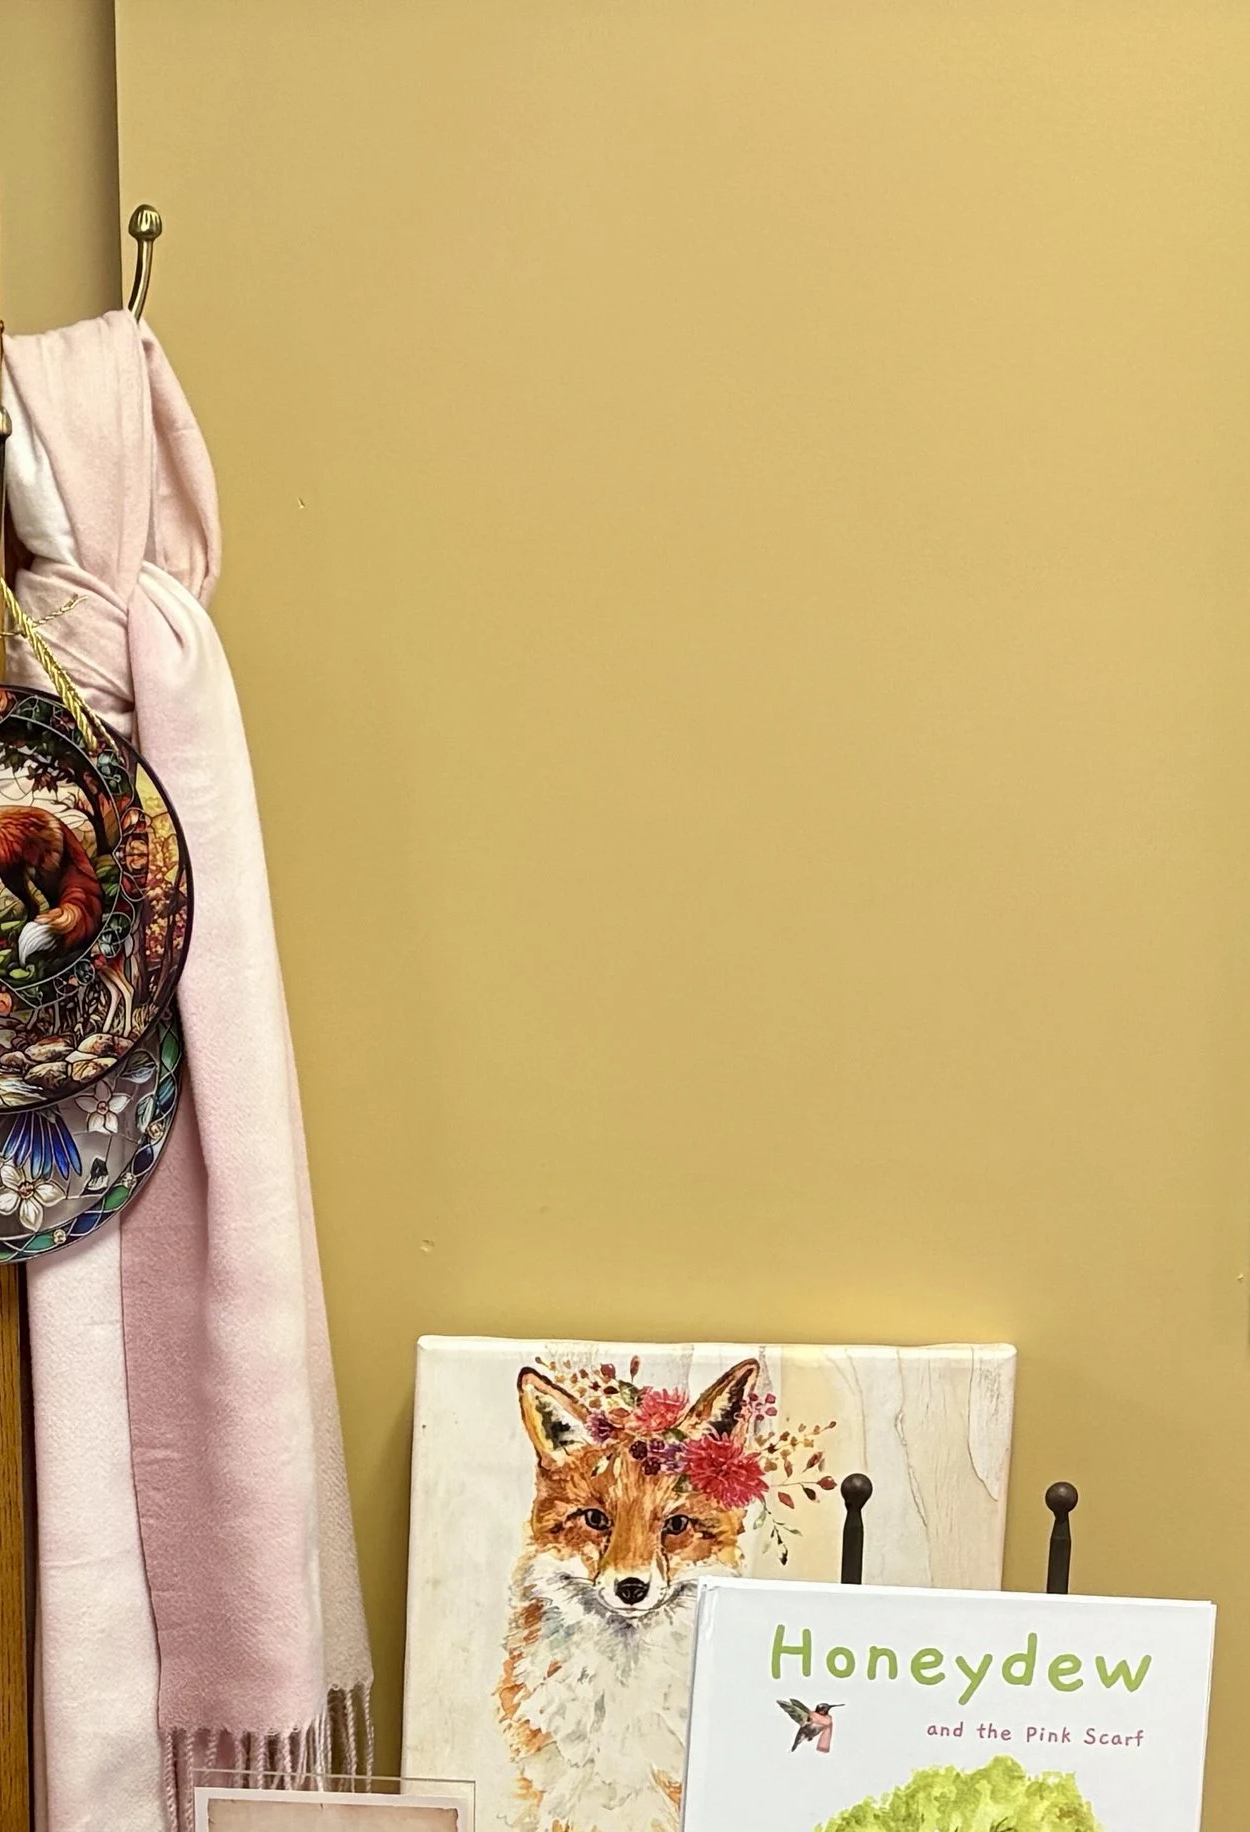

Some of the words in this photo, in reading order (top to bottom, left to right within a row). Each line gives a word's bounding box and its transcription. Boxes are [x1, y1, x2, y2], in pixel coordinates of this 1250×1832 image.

[770, 1624, 1152, 1705] Honeydew
[926, 1721, 964, 1739] and
[978, 1722, 1012, 1742] the
[1027, 1726, 1071, 1744] Pink
[1084, 1728, 1145, 1748] Scarf
